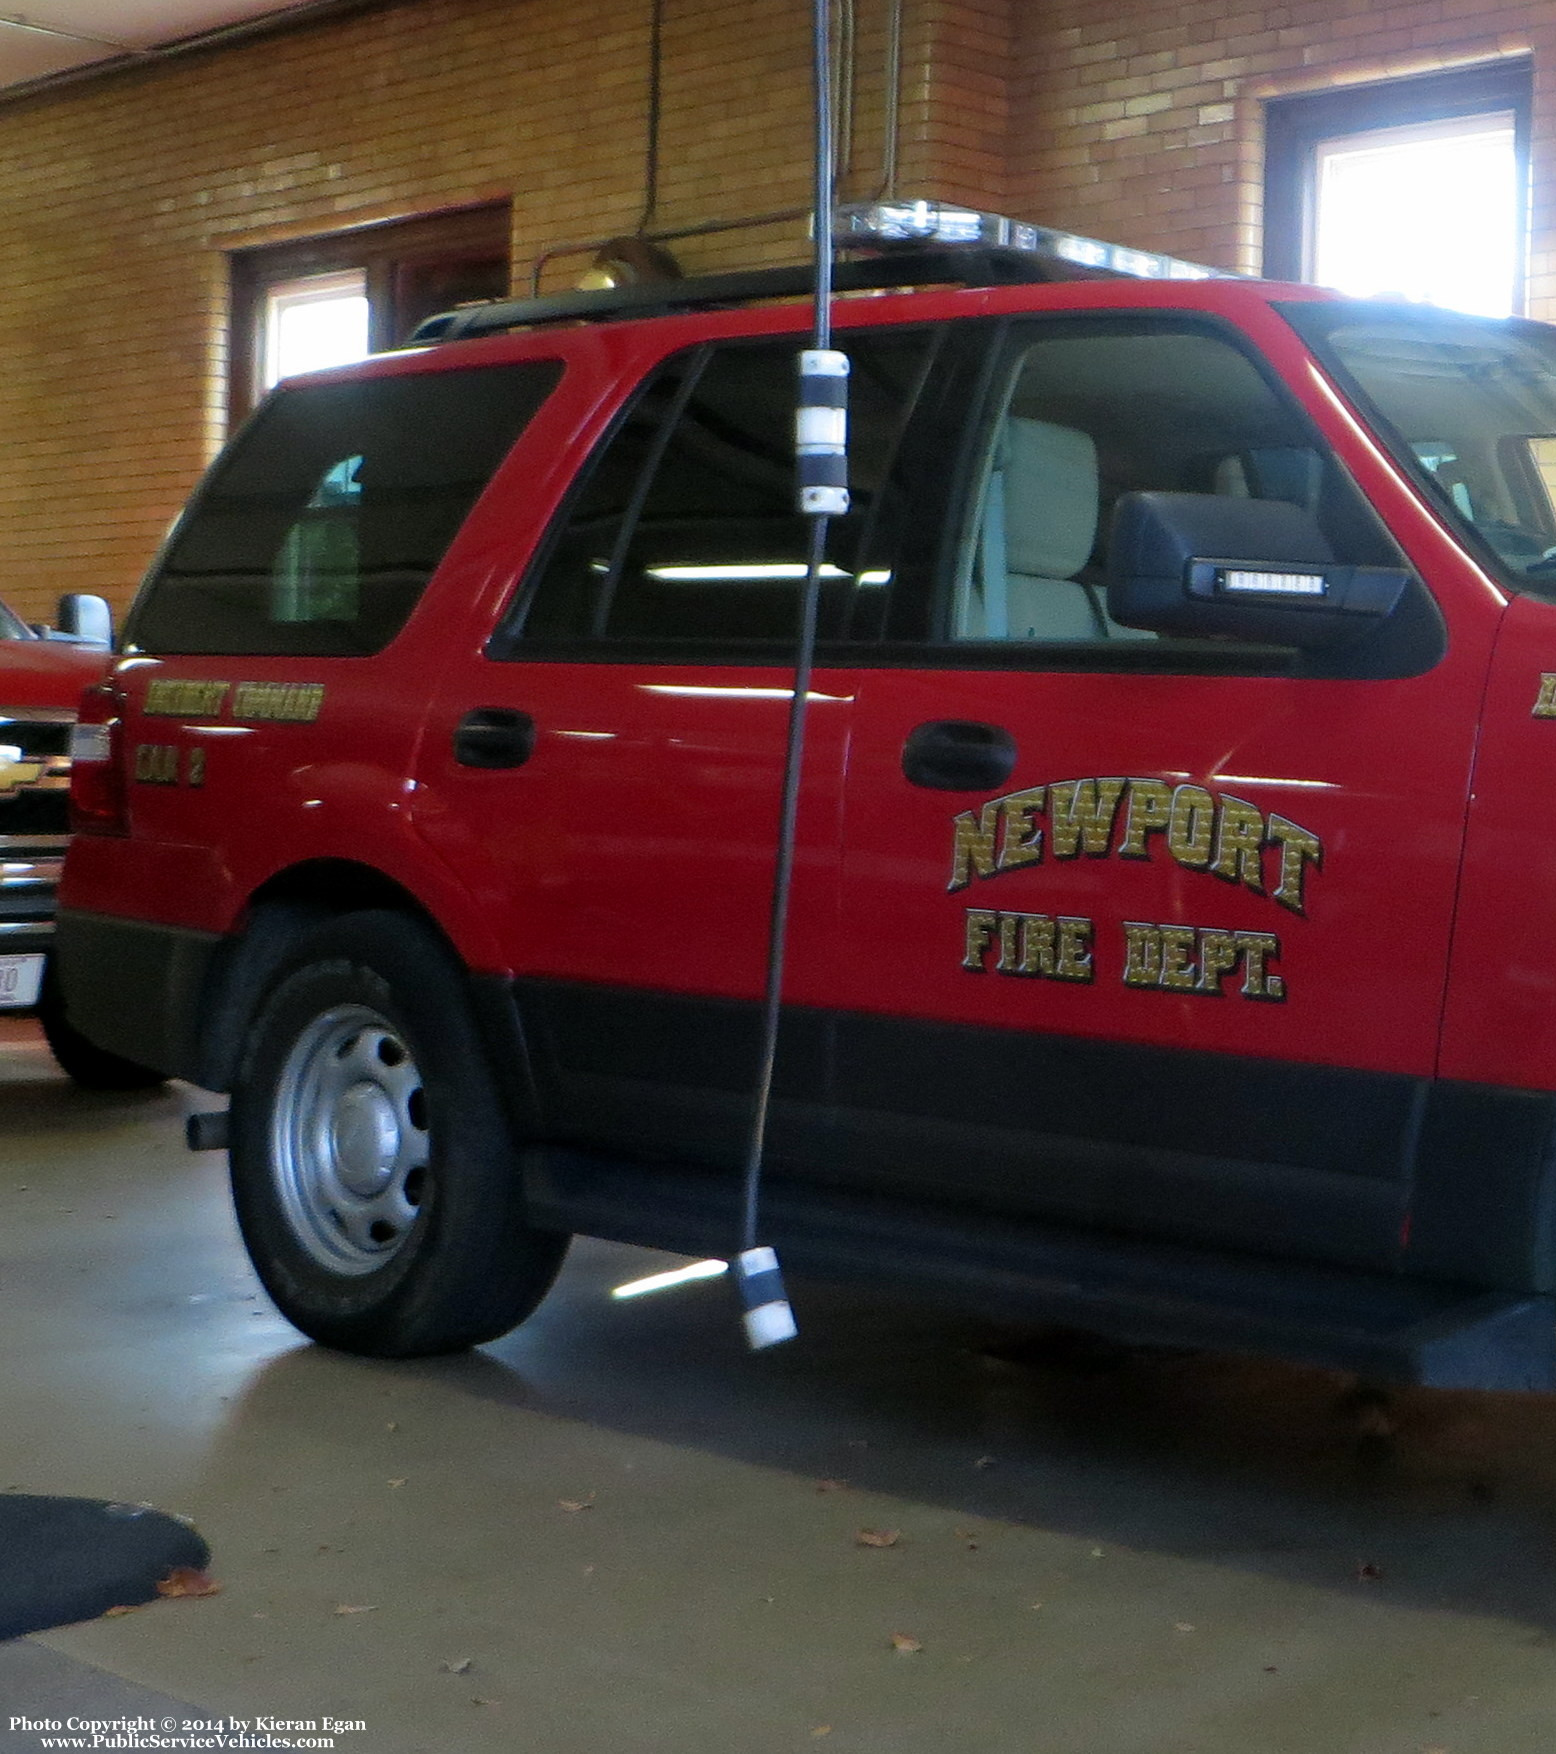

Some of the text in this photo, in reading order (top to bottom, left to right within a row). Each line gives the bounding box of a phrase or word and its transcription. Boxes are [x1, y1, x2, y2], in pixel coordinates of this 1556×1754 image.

[946, 776, 1326, 918] NEWPORT
[961, 907, 1288, 1004] FIRE DEPT.
